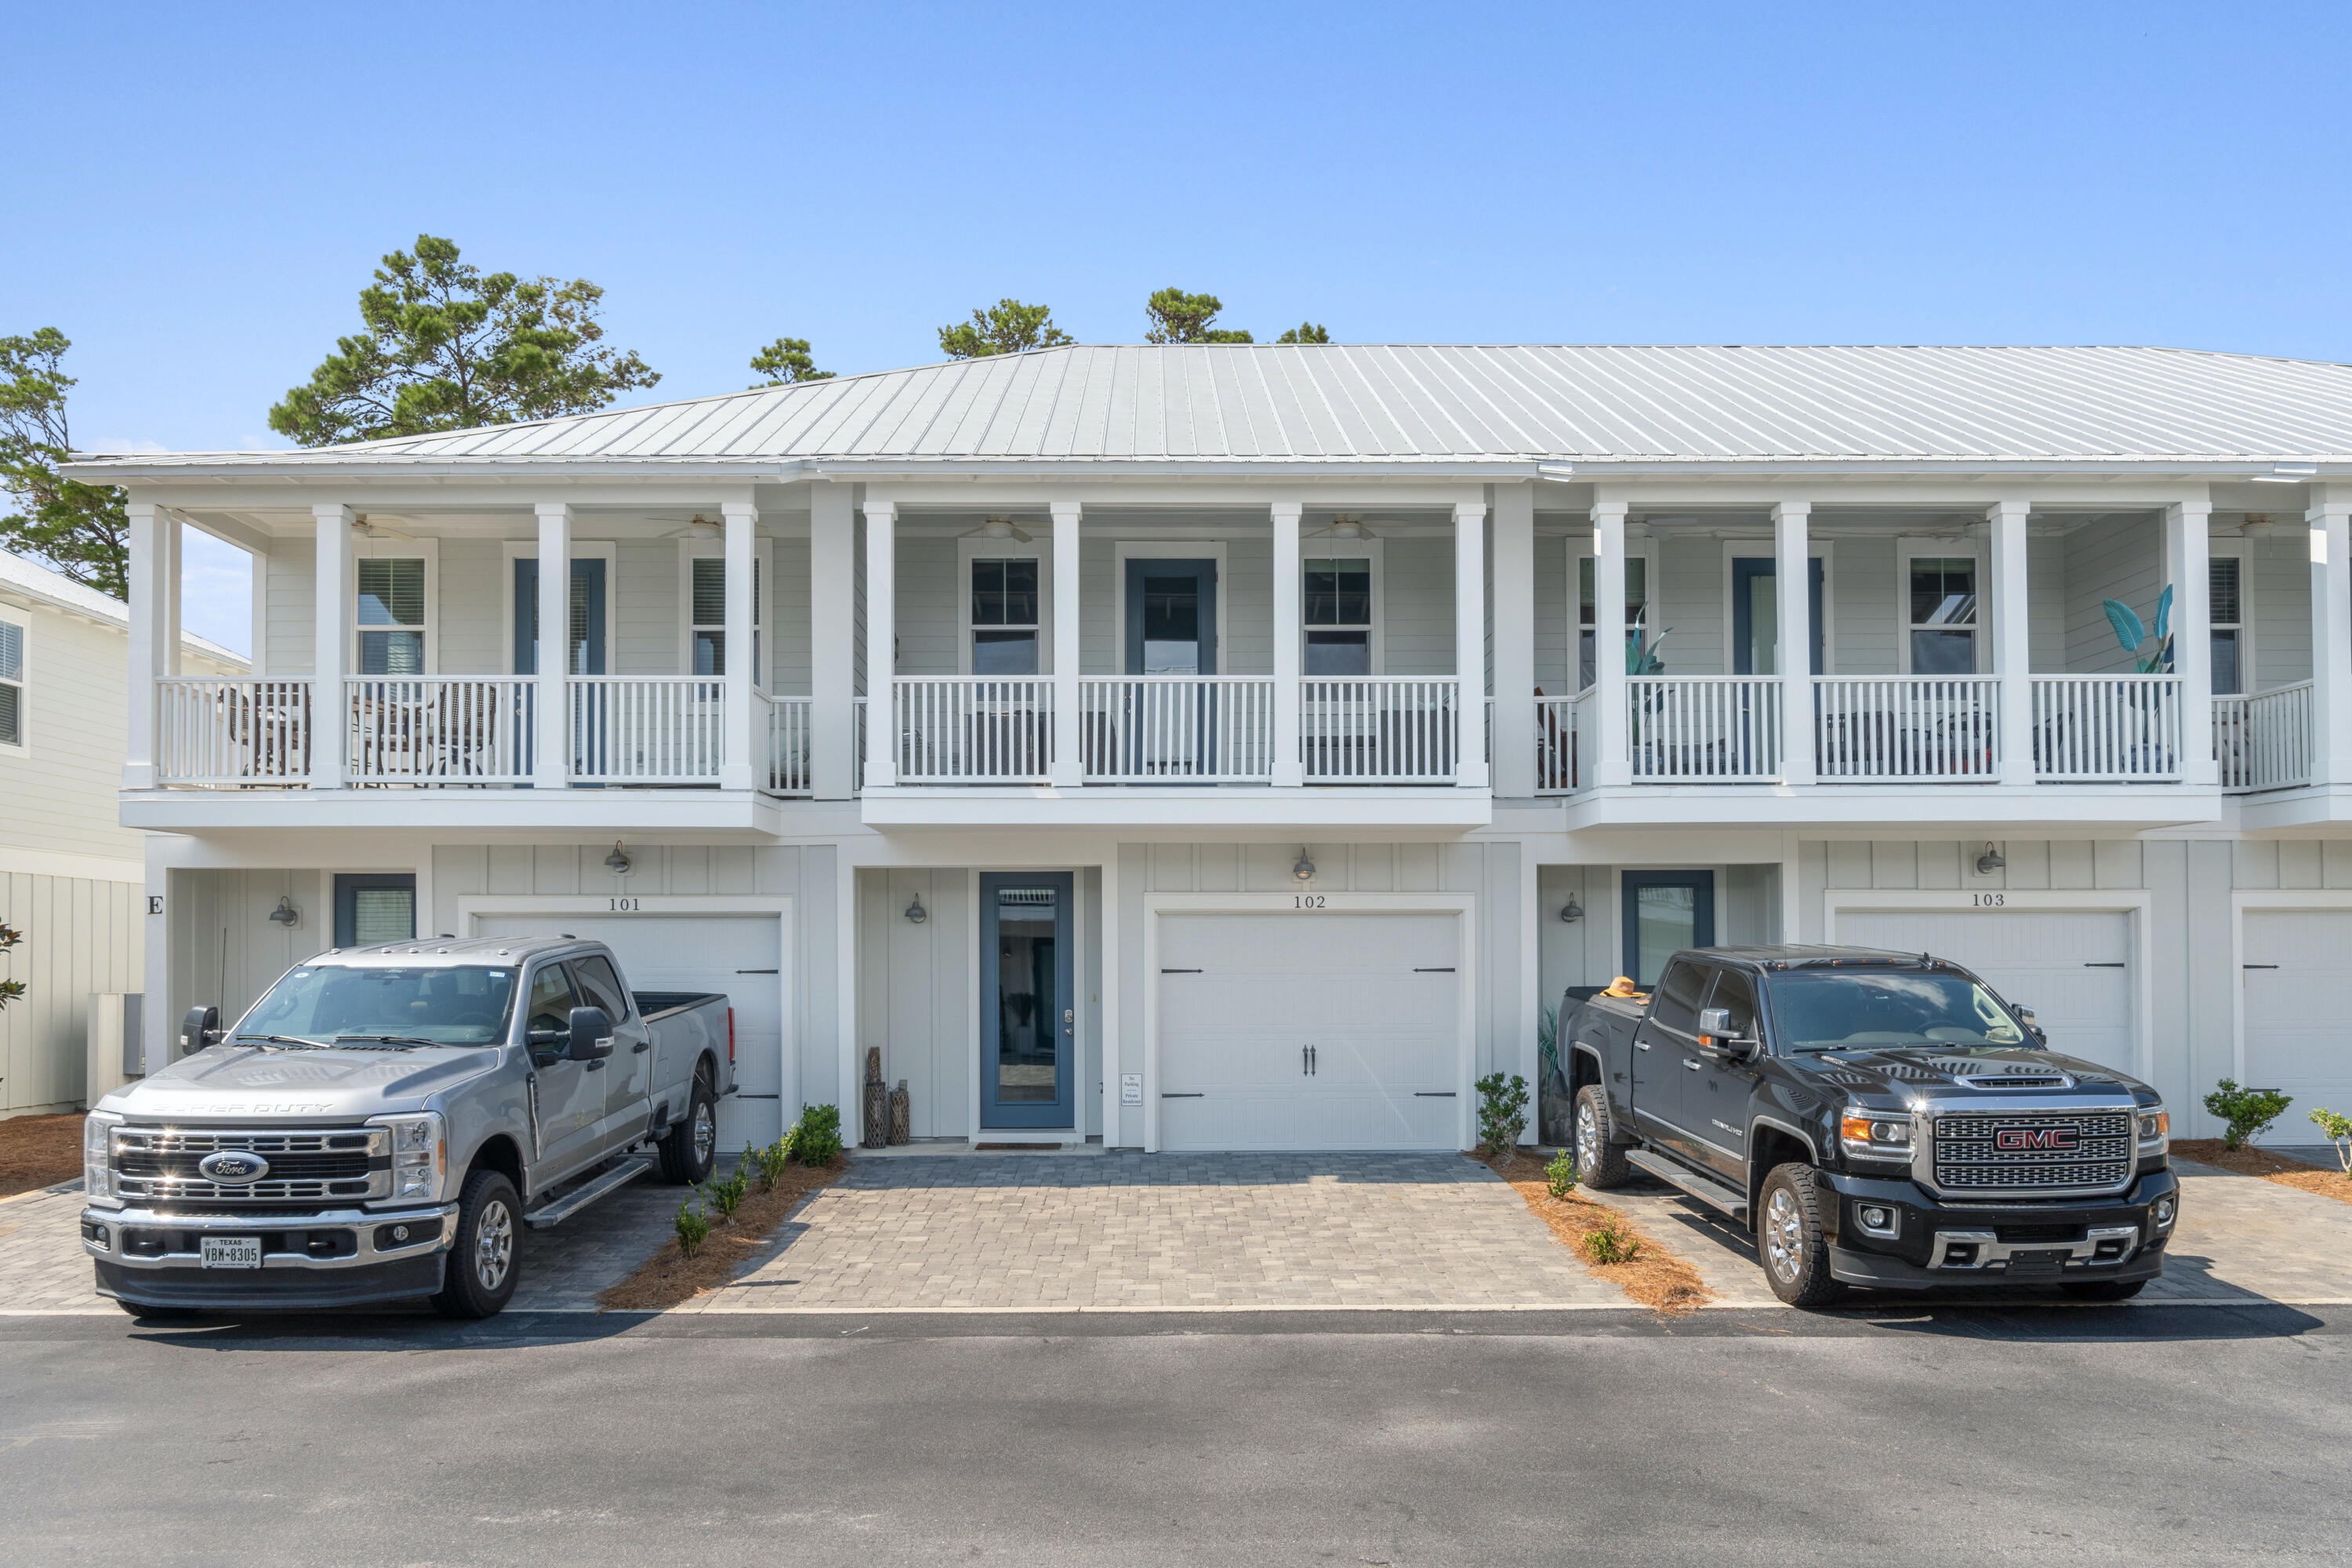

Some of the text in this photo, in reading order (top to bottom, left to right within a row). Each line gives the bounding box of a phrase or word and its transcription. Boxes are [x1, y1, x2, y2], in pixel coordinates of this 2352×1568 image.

[147, 895, 164, 915] E
[609, 898, 640, 911] 101
[1294, 895, 1325, 909] 102
[1973, 894, 2004, 906] 103
[253, 1104, 335, 1113] DUTY
[1997, 1129, 2077, 1149] GMC
[215, 1160, 249, 1175] Ford
